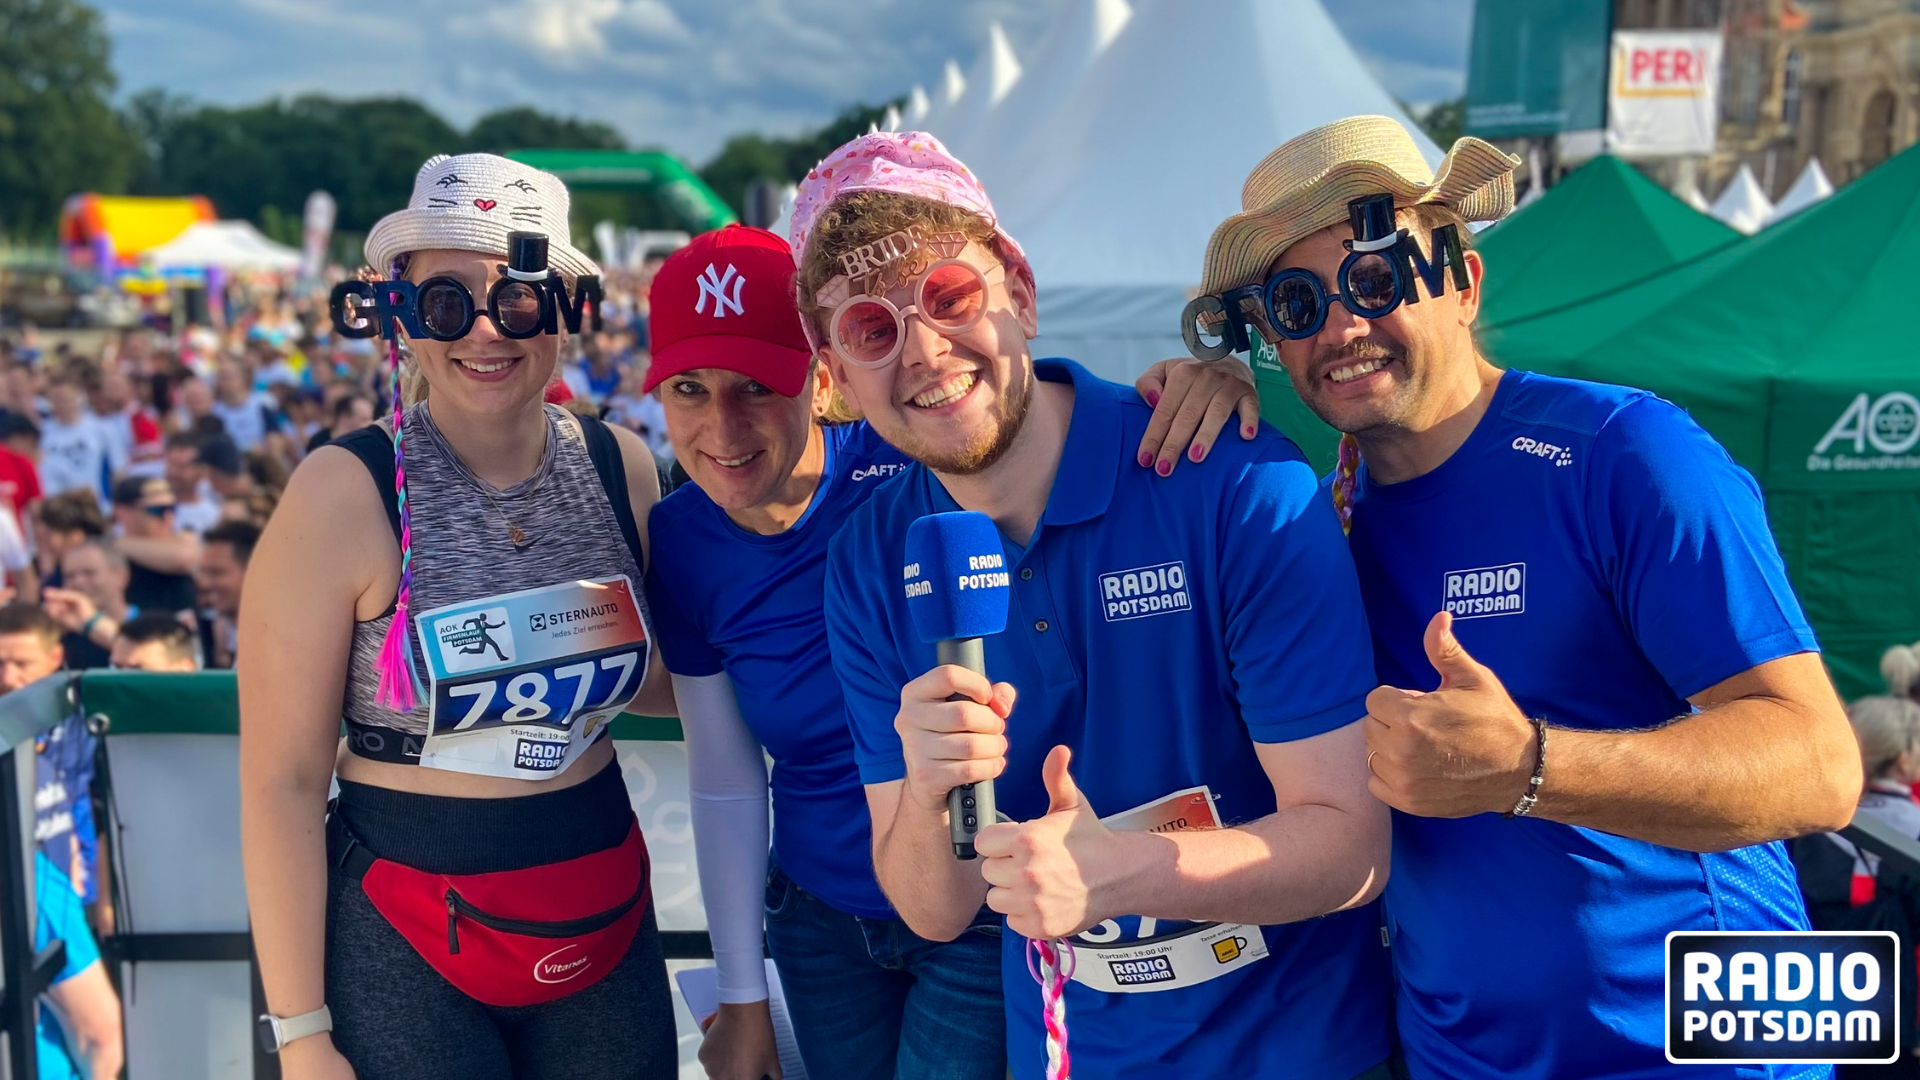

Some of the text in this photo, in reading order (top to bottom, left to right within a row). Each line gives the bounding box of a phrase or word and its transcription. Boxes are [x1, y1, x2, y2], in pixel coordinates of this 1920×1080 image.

[1630, 48, 1707, 84] PERI
[694, 262, 746, 318] NY
[1813, 391, 1920, 454] AO
[1511, 436, 1562, 461] CRAFT
[968, 553, 1003, 571] RADIO
[1103, 565, 1185, 600] RADIO
[1446, 567, 1521, 598] RADIO
[549, 602, 619, 626] STERNAUTO
[1107, 591, 1188, 617] POTSDAM
[1446, 593, 1521, 615] POTSDAM
[440, 623, 459, 635] AOK
[551, 629, 572, 639] Jedes
[572, 625, 587, 635] Ziel
[453, 635, 483, 647] POTSDAM
[448, 651, 638, 730] 7877
[510, 728, 547, 740] Startzeit:
[517, 756, 565, 768] POTSDA
[1133, 948, 1157, 957] 19:00
[1157, 944, 1174, 953] Uhr
[1111, 958, 1168, 975] RADIO
[1117, 970, 1172, 983] POTSDAM
